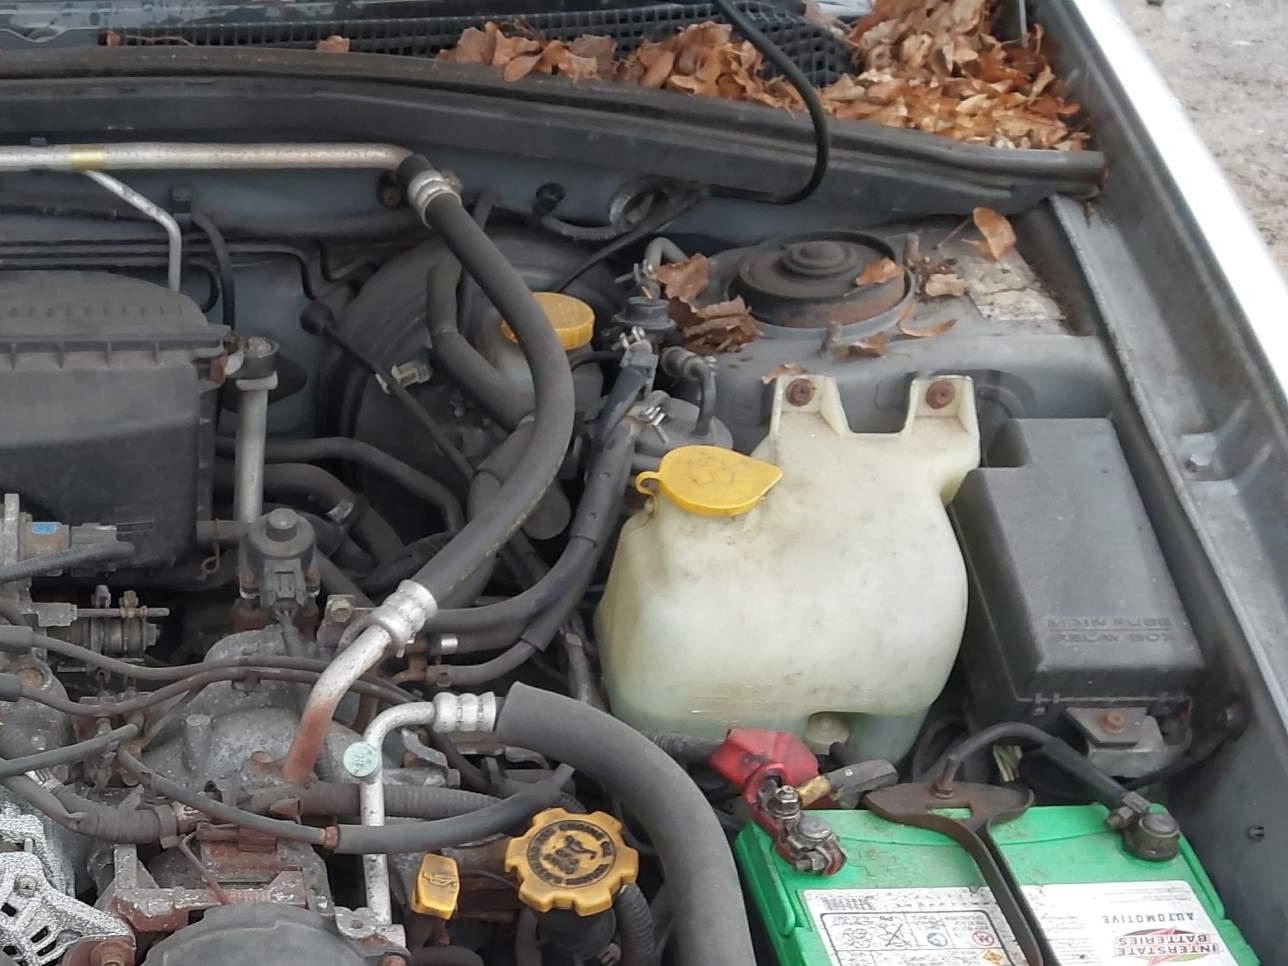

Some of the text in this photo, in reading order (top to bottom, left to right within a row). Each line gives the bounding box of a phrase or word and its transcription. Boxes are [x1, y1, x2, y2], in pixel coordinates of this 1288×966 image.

[1102, 912, 1195, 925] AUTOMOTIVE
[1117, 933, 1208, 946] BATTERIES
[1116, 944, 1220, 957] INTERSTATE
